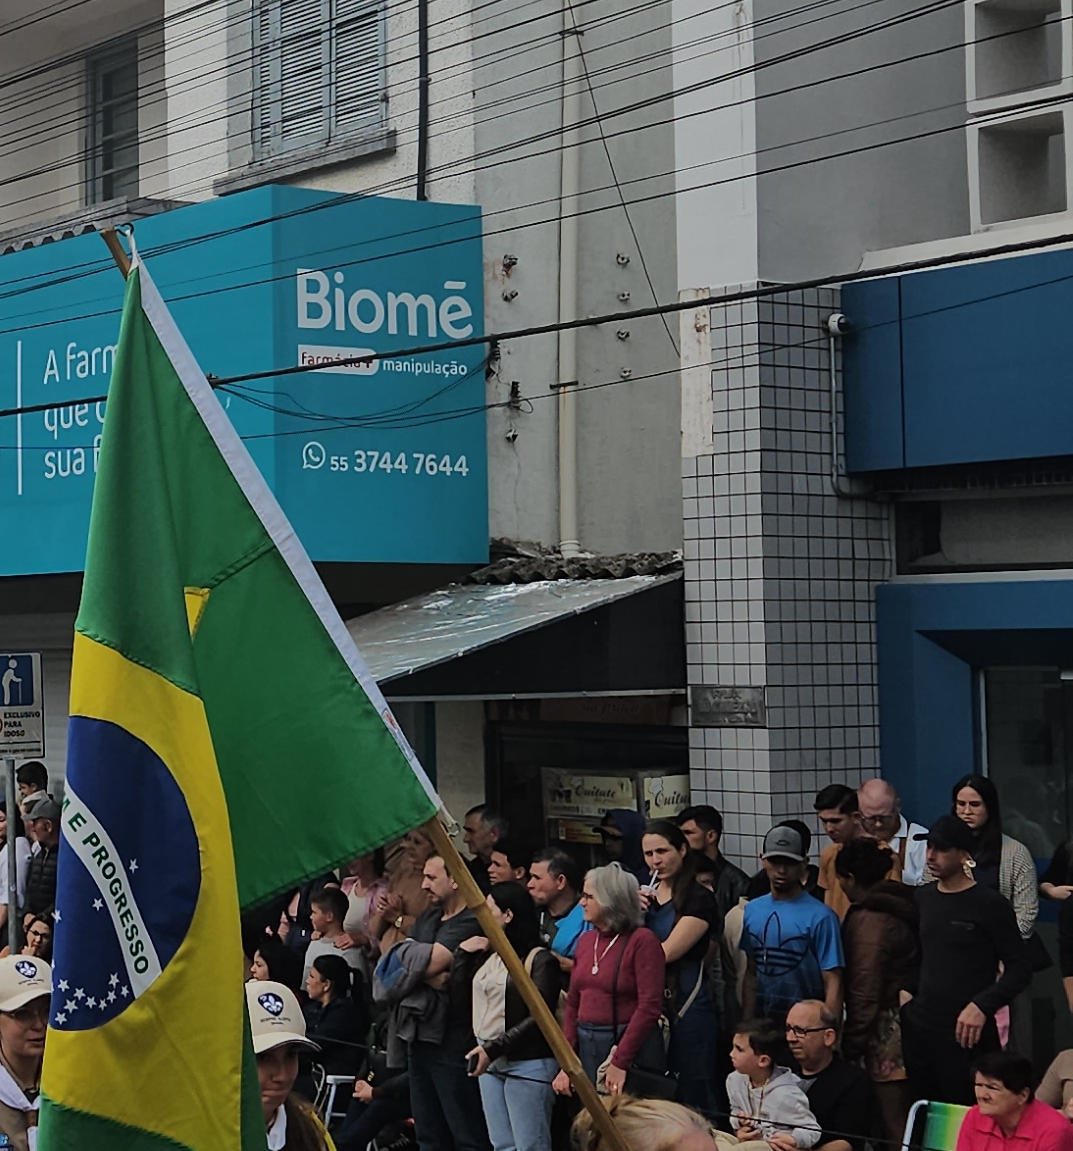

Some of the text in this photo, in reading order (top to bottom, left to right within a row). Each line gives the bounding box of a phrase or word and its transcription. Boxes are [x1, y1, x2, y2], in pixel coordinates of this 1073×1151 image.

[43, 341, 118, 385] A farm
[383, 358, 468, 378] manipulação
[44, 403, 89, 441] que
[44, 447, 86, 479] sua
[330, 450, 469, 477] 55 3744 7644
[4, 711, 41, 719] EXCLUSIVO
[68, 812, 149, 975] E PROGRESSO
